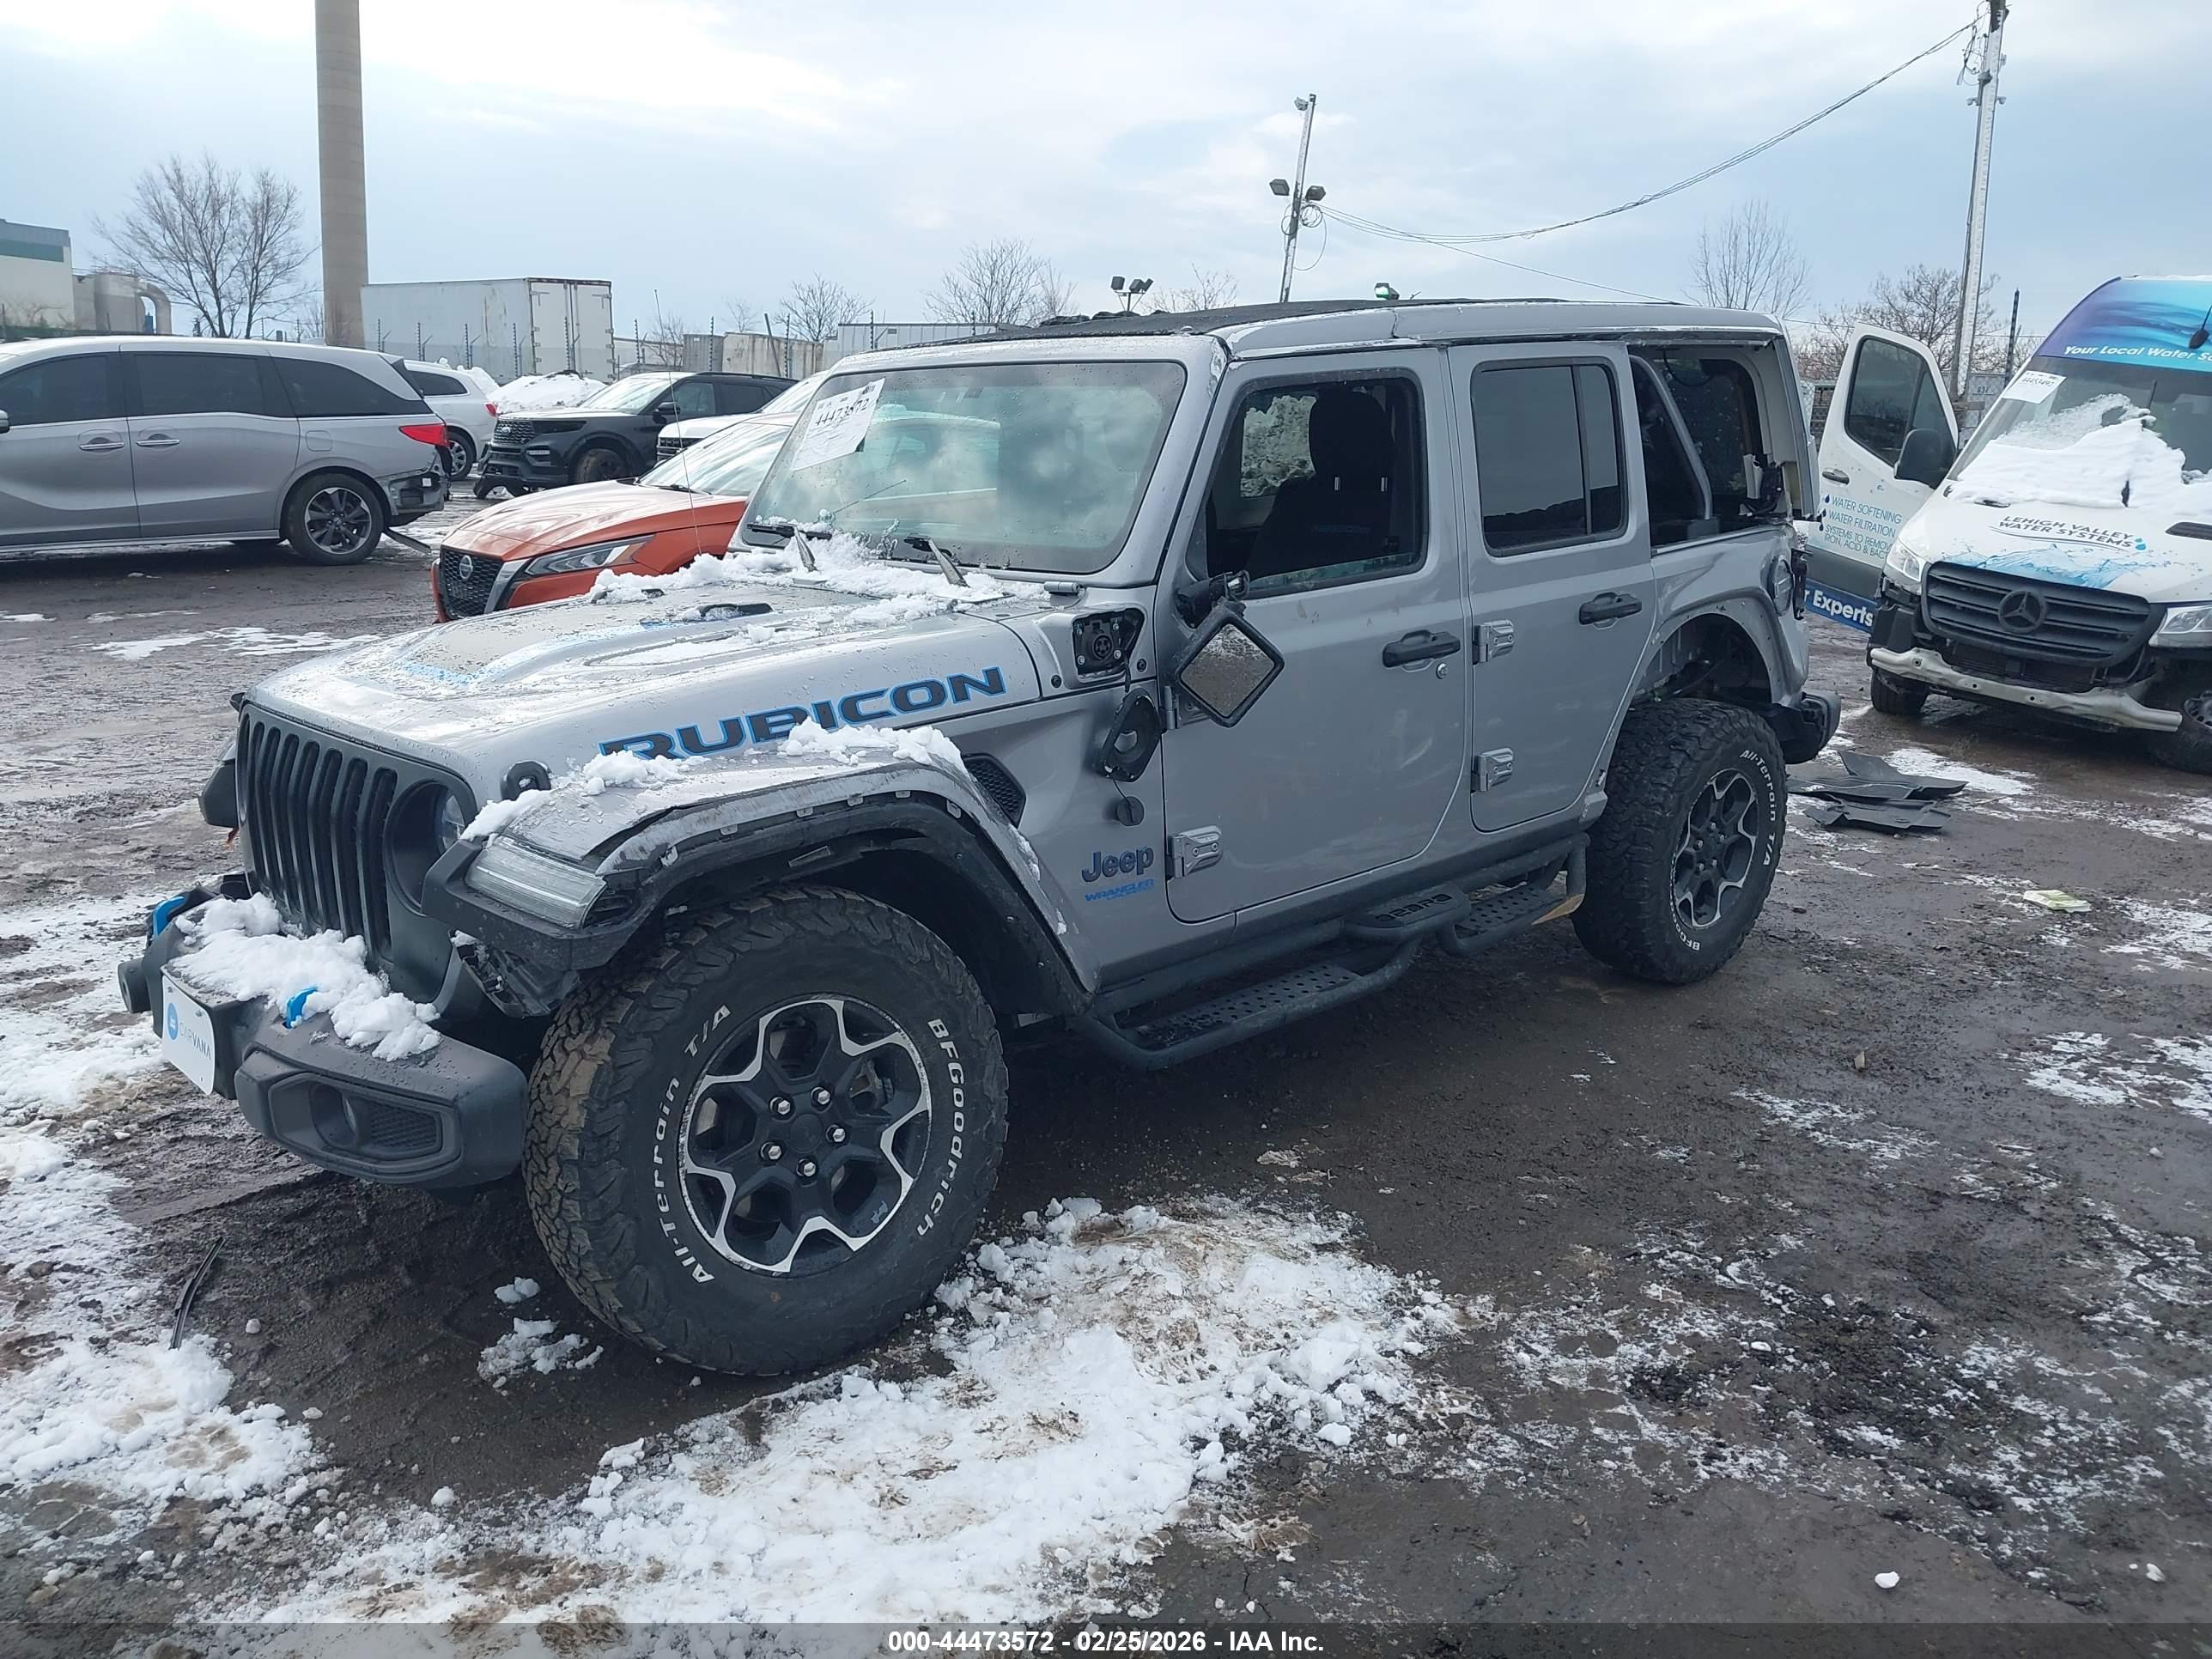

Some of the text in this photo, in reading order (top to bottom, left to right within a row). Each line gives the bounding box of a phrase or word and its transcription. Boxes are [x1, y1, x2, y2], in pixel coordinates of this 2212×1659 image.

[2064, 345, 2099, 355] Your
[2100, 345, 2144, 356] Local
[2148, 347, 2196, 359] Water
[1829, 510, 1896, 538] WATER FILTRATION
[1832, 495, 1902, 524] WATER SOFTENING
[1825, 524, 1852, 539] SYSTEMS
[1854, 532, 1863, 543] TO
[1999, 521, 2134, 548] WATER SYSTEMS
[2003, 515, 2134, 540] LEHIGH VALLEY
[1844, 539, 1862, 552] ACID
[1863, 545, 1869, 554] &
[1813, 589, 1874, 627] Experts
[599, 665, 1006, 761] RUBICON
[1740, 749, 1776, 866] All-Terrain T/A
[1081, 847, 1154, 883] Jeep
[179, 1021, 212, 1060] CARVANA
[917, 1018, 964, 1237] BFGoodrich
[653, 1004, 732, 1284] All-Terrain T/A
